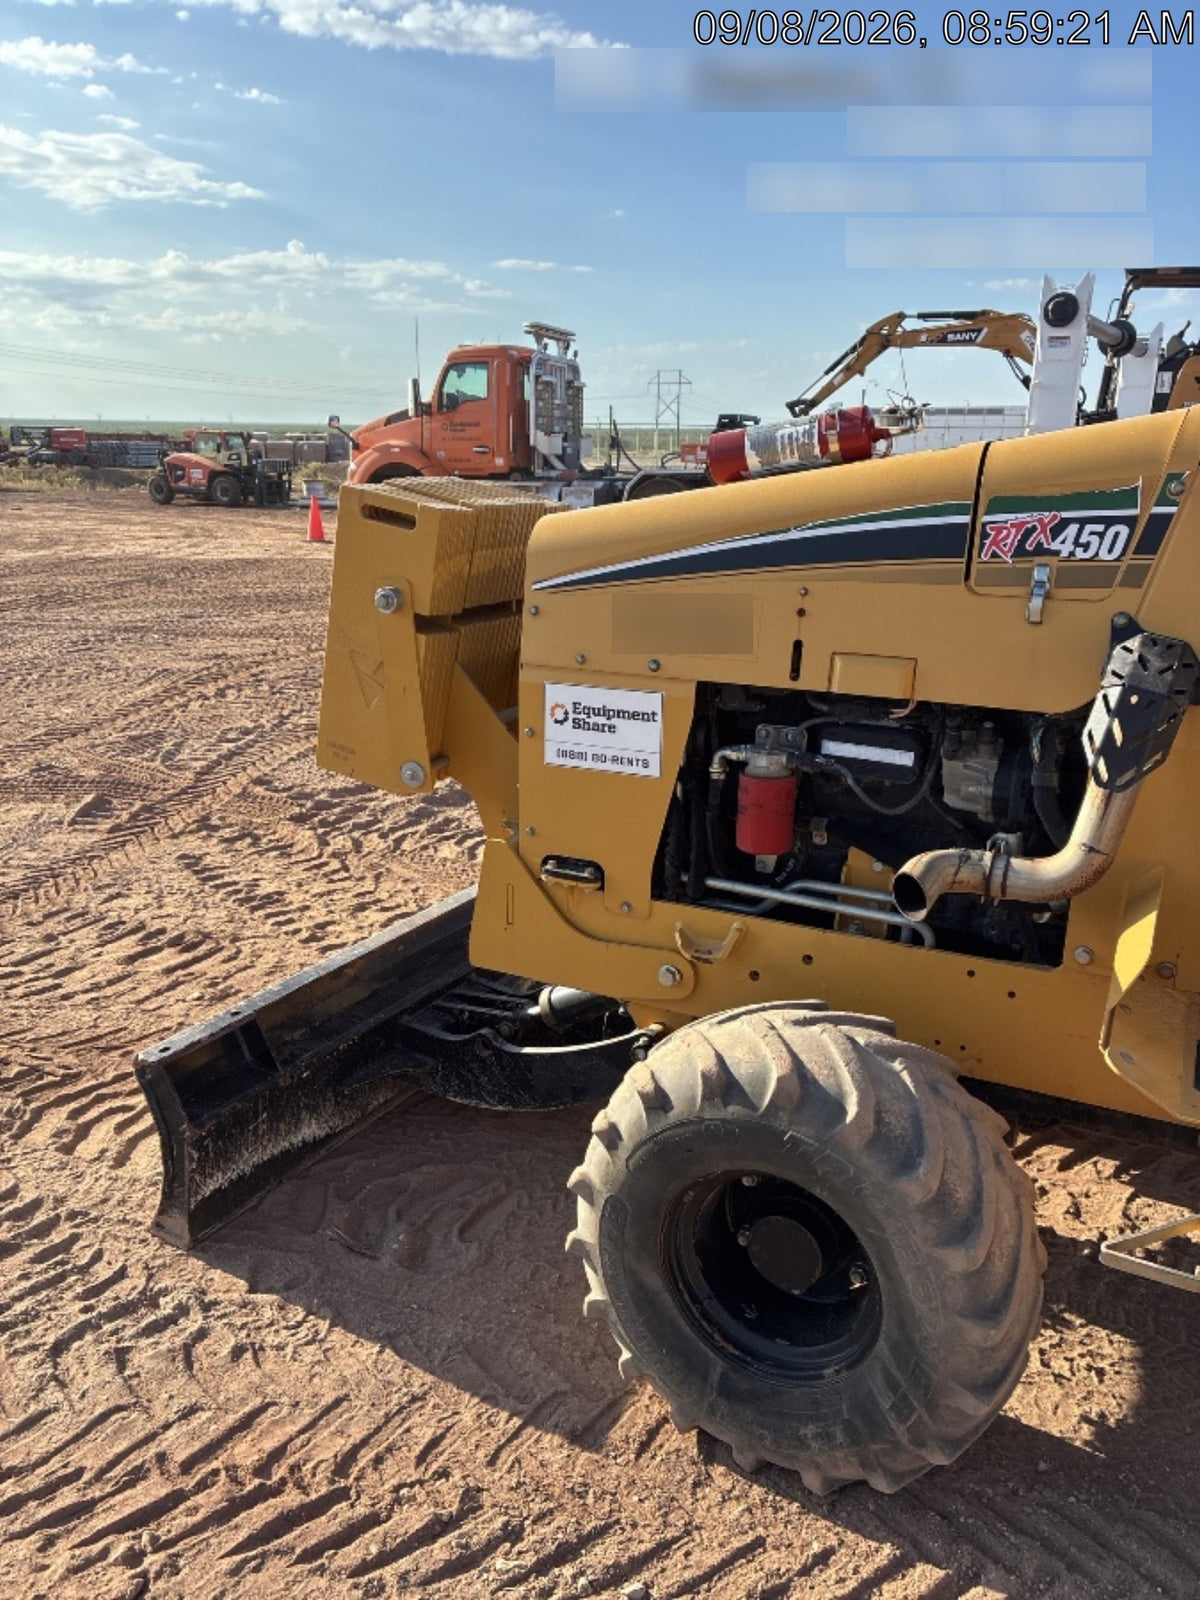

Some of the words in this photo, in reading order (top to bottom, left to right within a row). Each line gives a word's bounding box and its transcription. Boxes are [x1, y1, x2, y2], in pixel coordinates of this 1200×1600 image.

[947, 332, 978, 342] SANY
[572, 702, 658, 722] Equipment
[572, 718, 617, 733] Share
